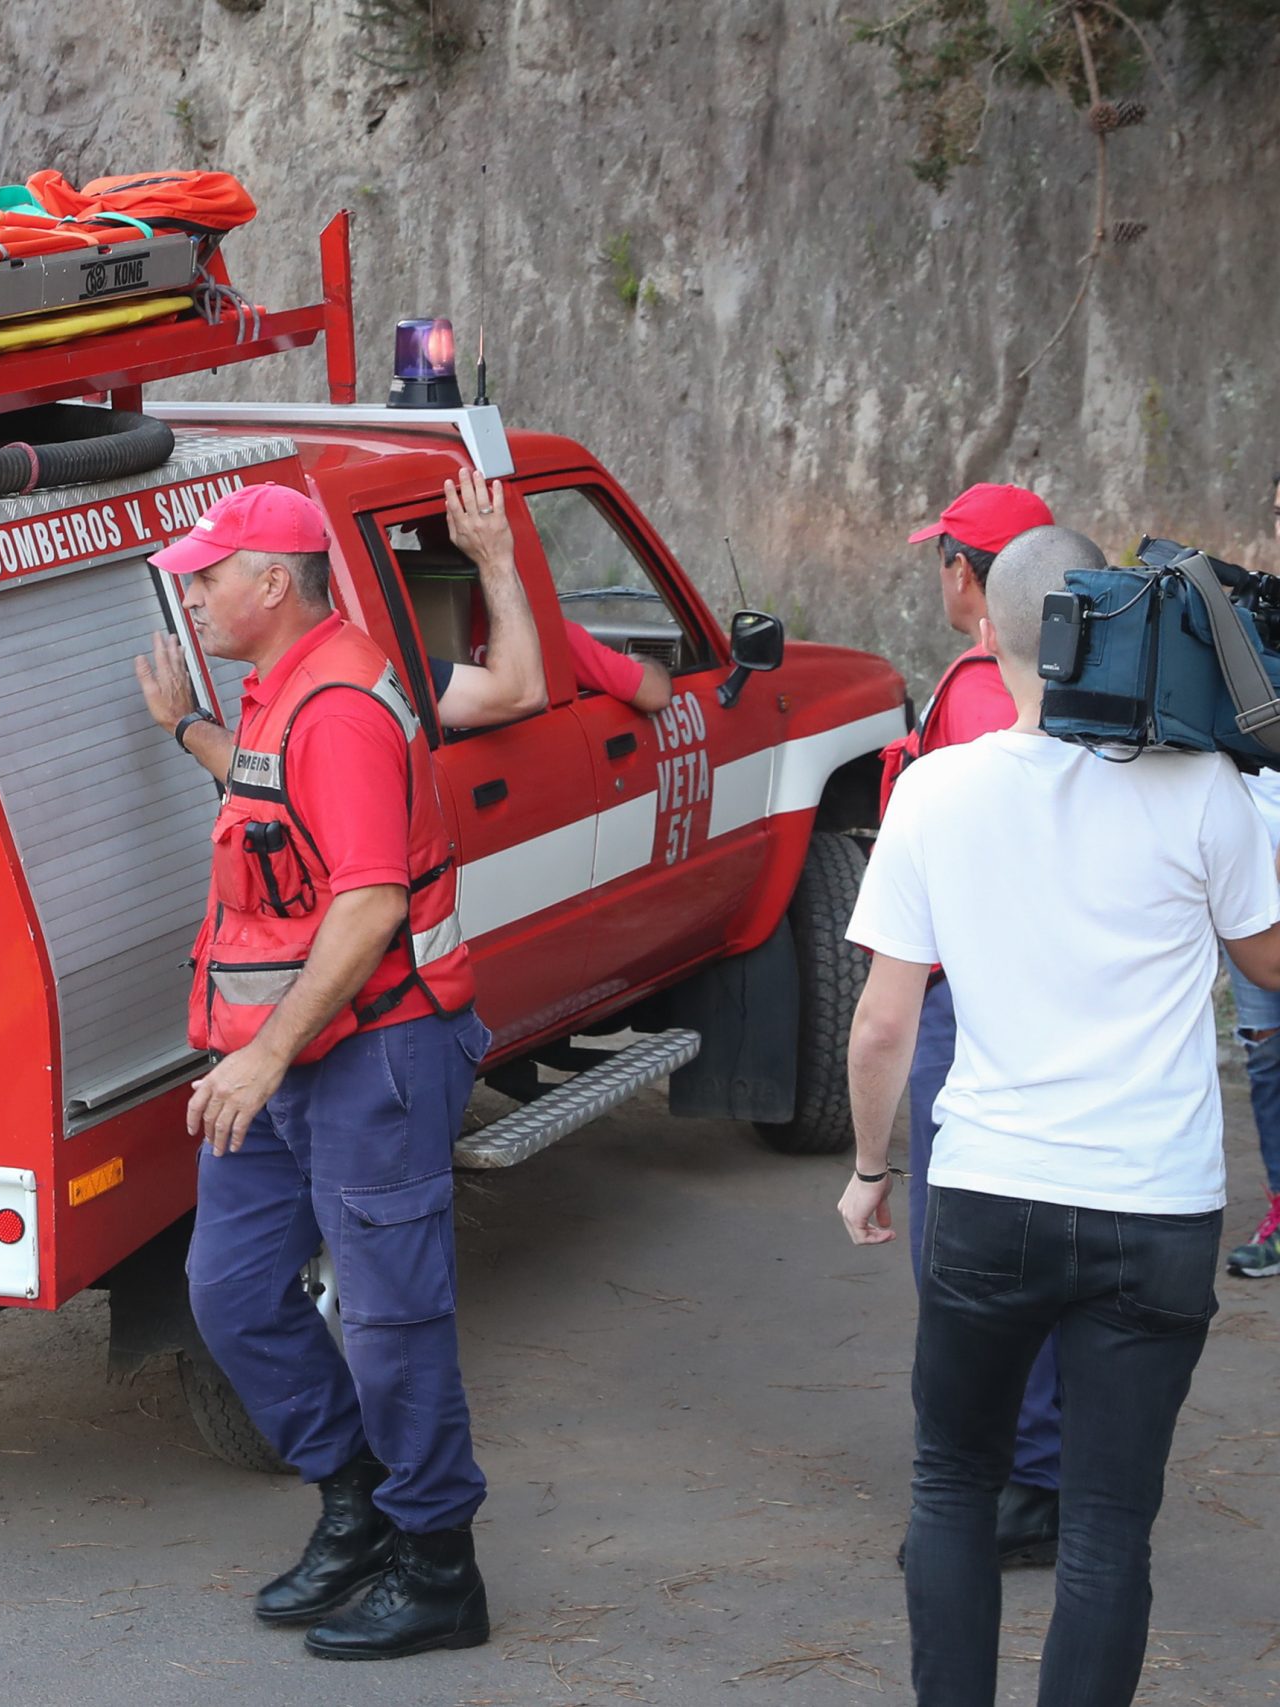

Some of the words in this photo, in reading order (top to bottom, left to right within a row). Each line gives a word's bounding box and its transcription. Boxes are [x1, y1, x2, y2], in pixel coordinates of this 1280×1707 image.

[114, 260, 143, 286] KONG
[124, 499, 152, 541] V.
[648, 690, 706, 752] 1950
[656, 748, 710, 813] VETA
[665, 809, 693, 866] 51
